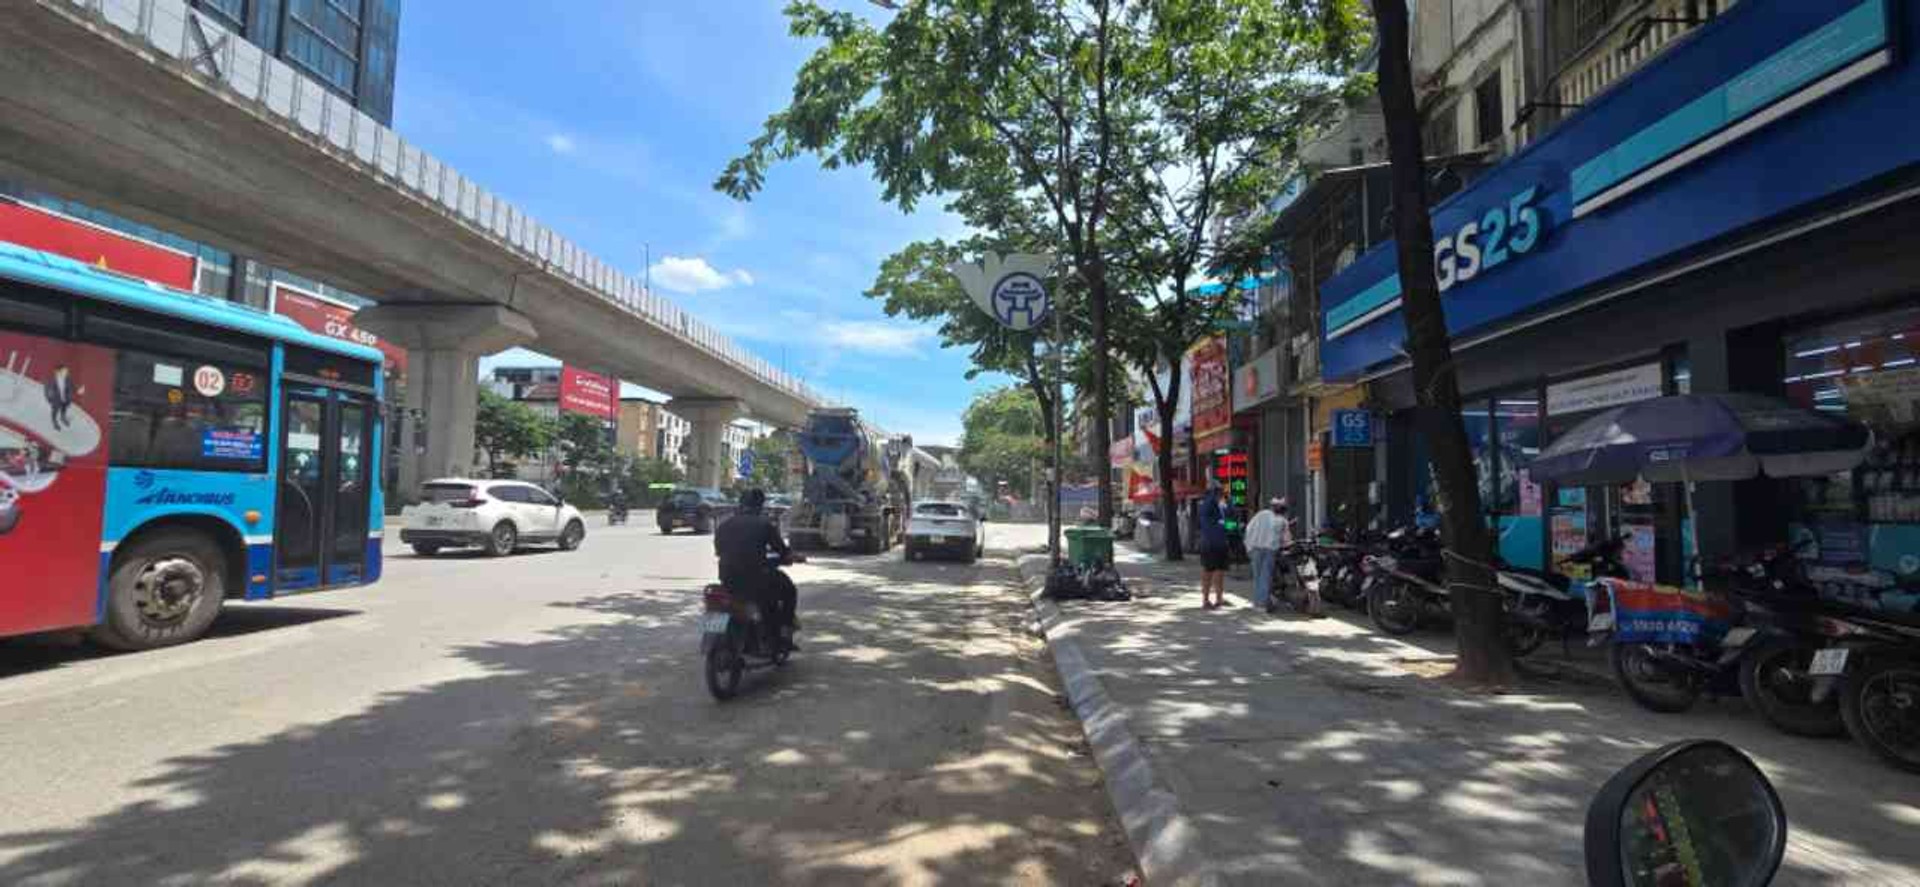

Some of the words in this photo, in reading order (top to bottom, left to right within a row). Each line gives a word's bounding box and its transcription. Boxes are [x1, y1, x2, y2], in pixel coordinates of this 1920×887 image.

[1433, 185, 1539, 292] GS25
[324, 321, 348, 338] GX
[200, 370, 221, 391] 02
[1342, 412, 1366, 428] GS
